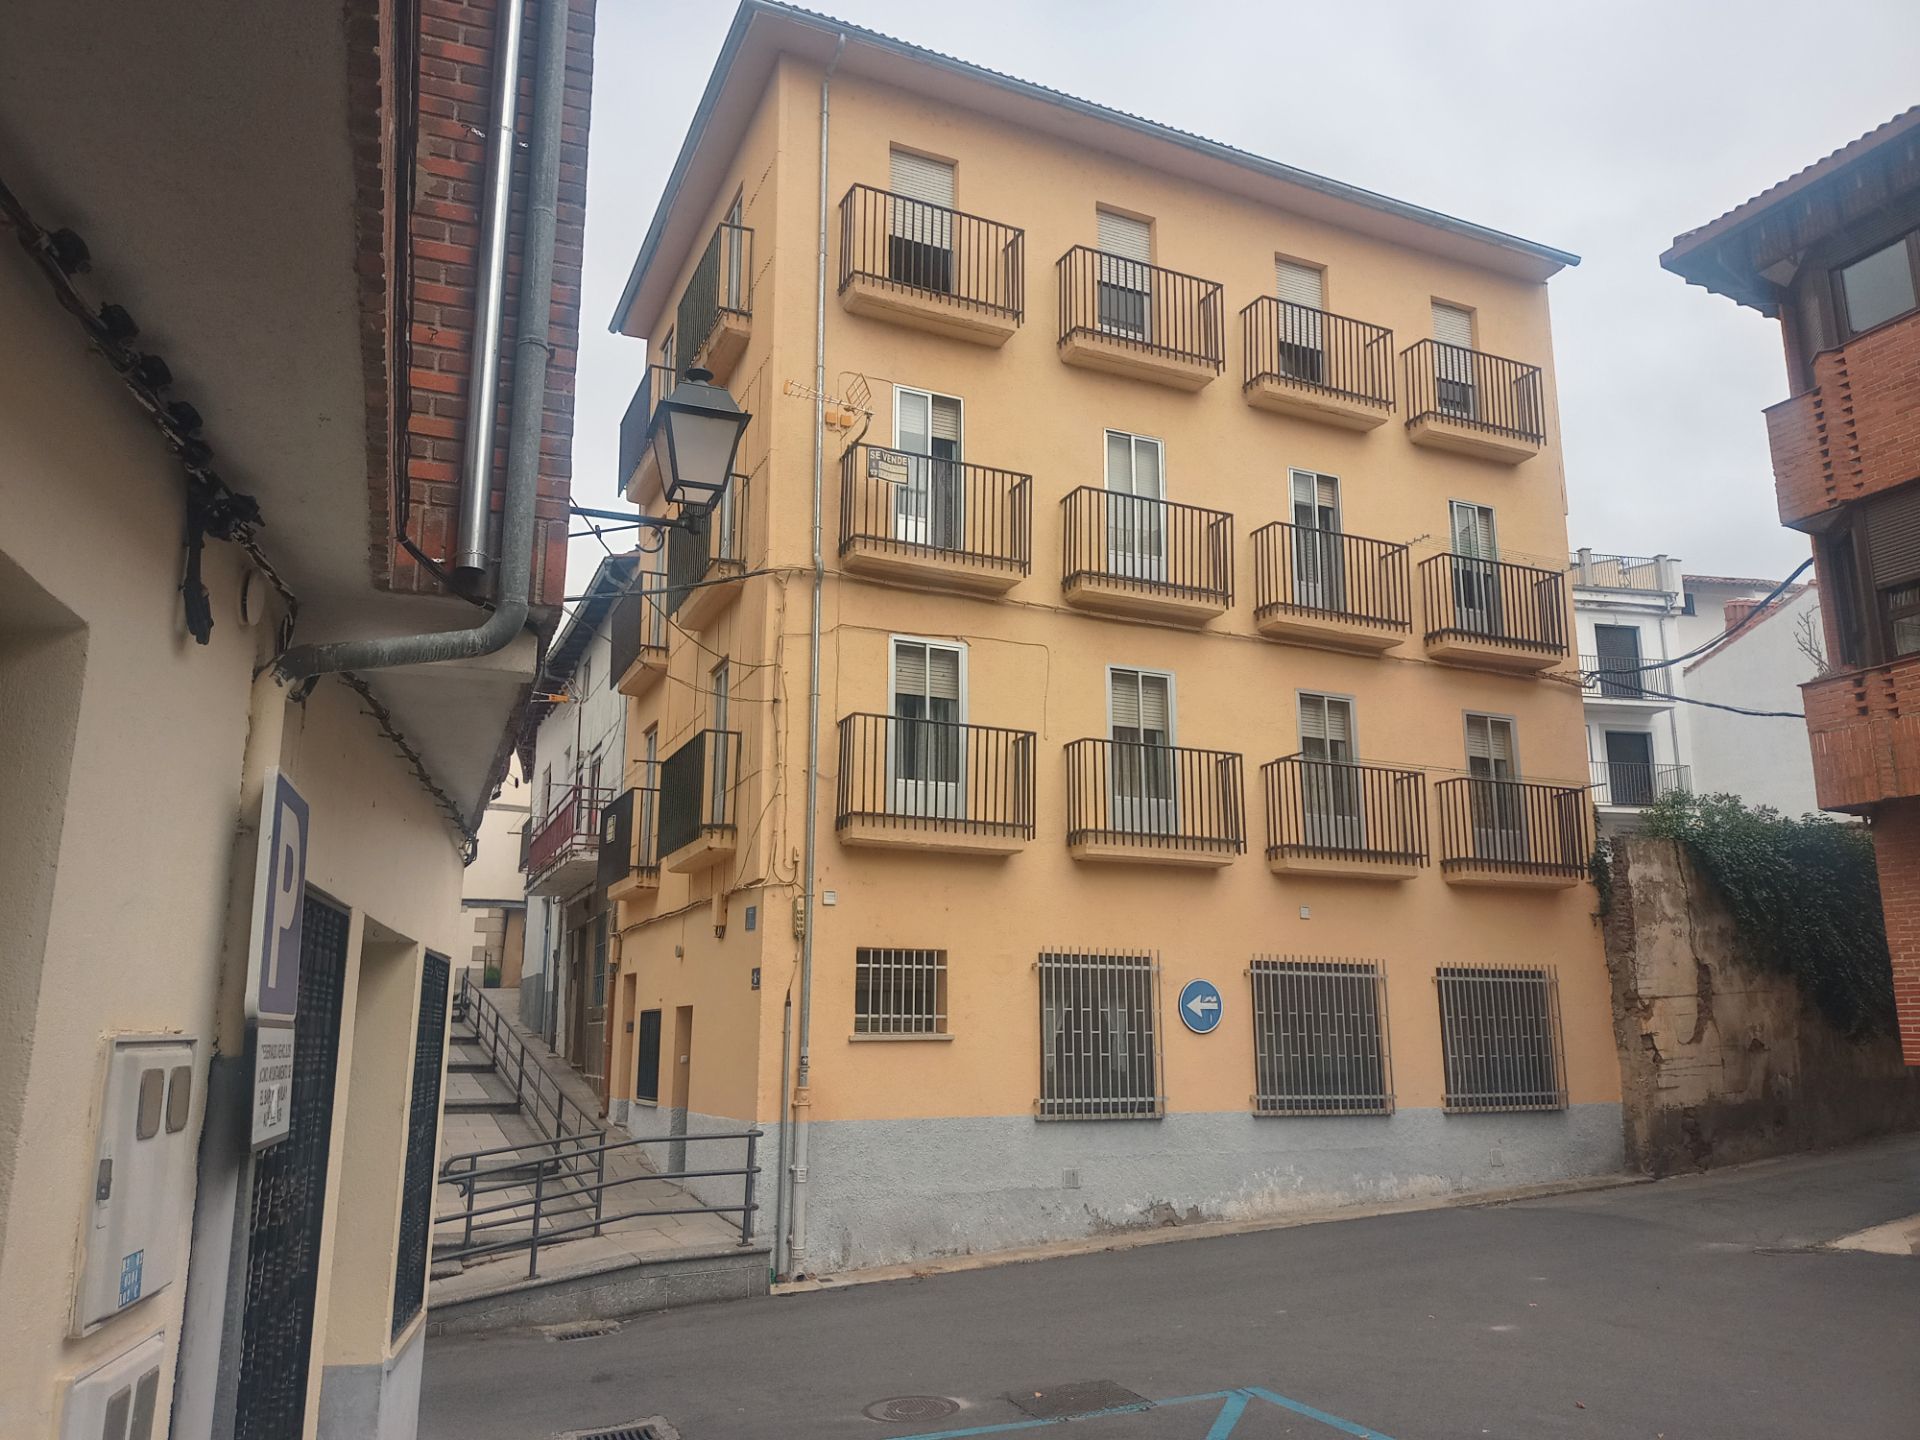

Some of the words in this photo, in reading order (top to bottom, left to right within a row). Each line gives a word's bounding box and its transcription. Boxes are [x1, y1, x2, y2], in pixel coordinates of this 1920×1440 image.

[870, 450, 881, 460] SE
[882, 452, 908, 466] VENDE
[267, 801, 300, 988] P
